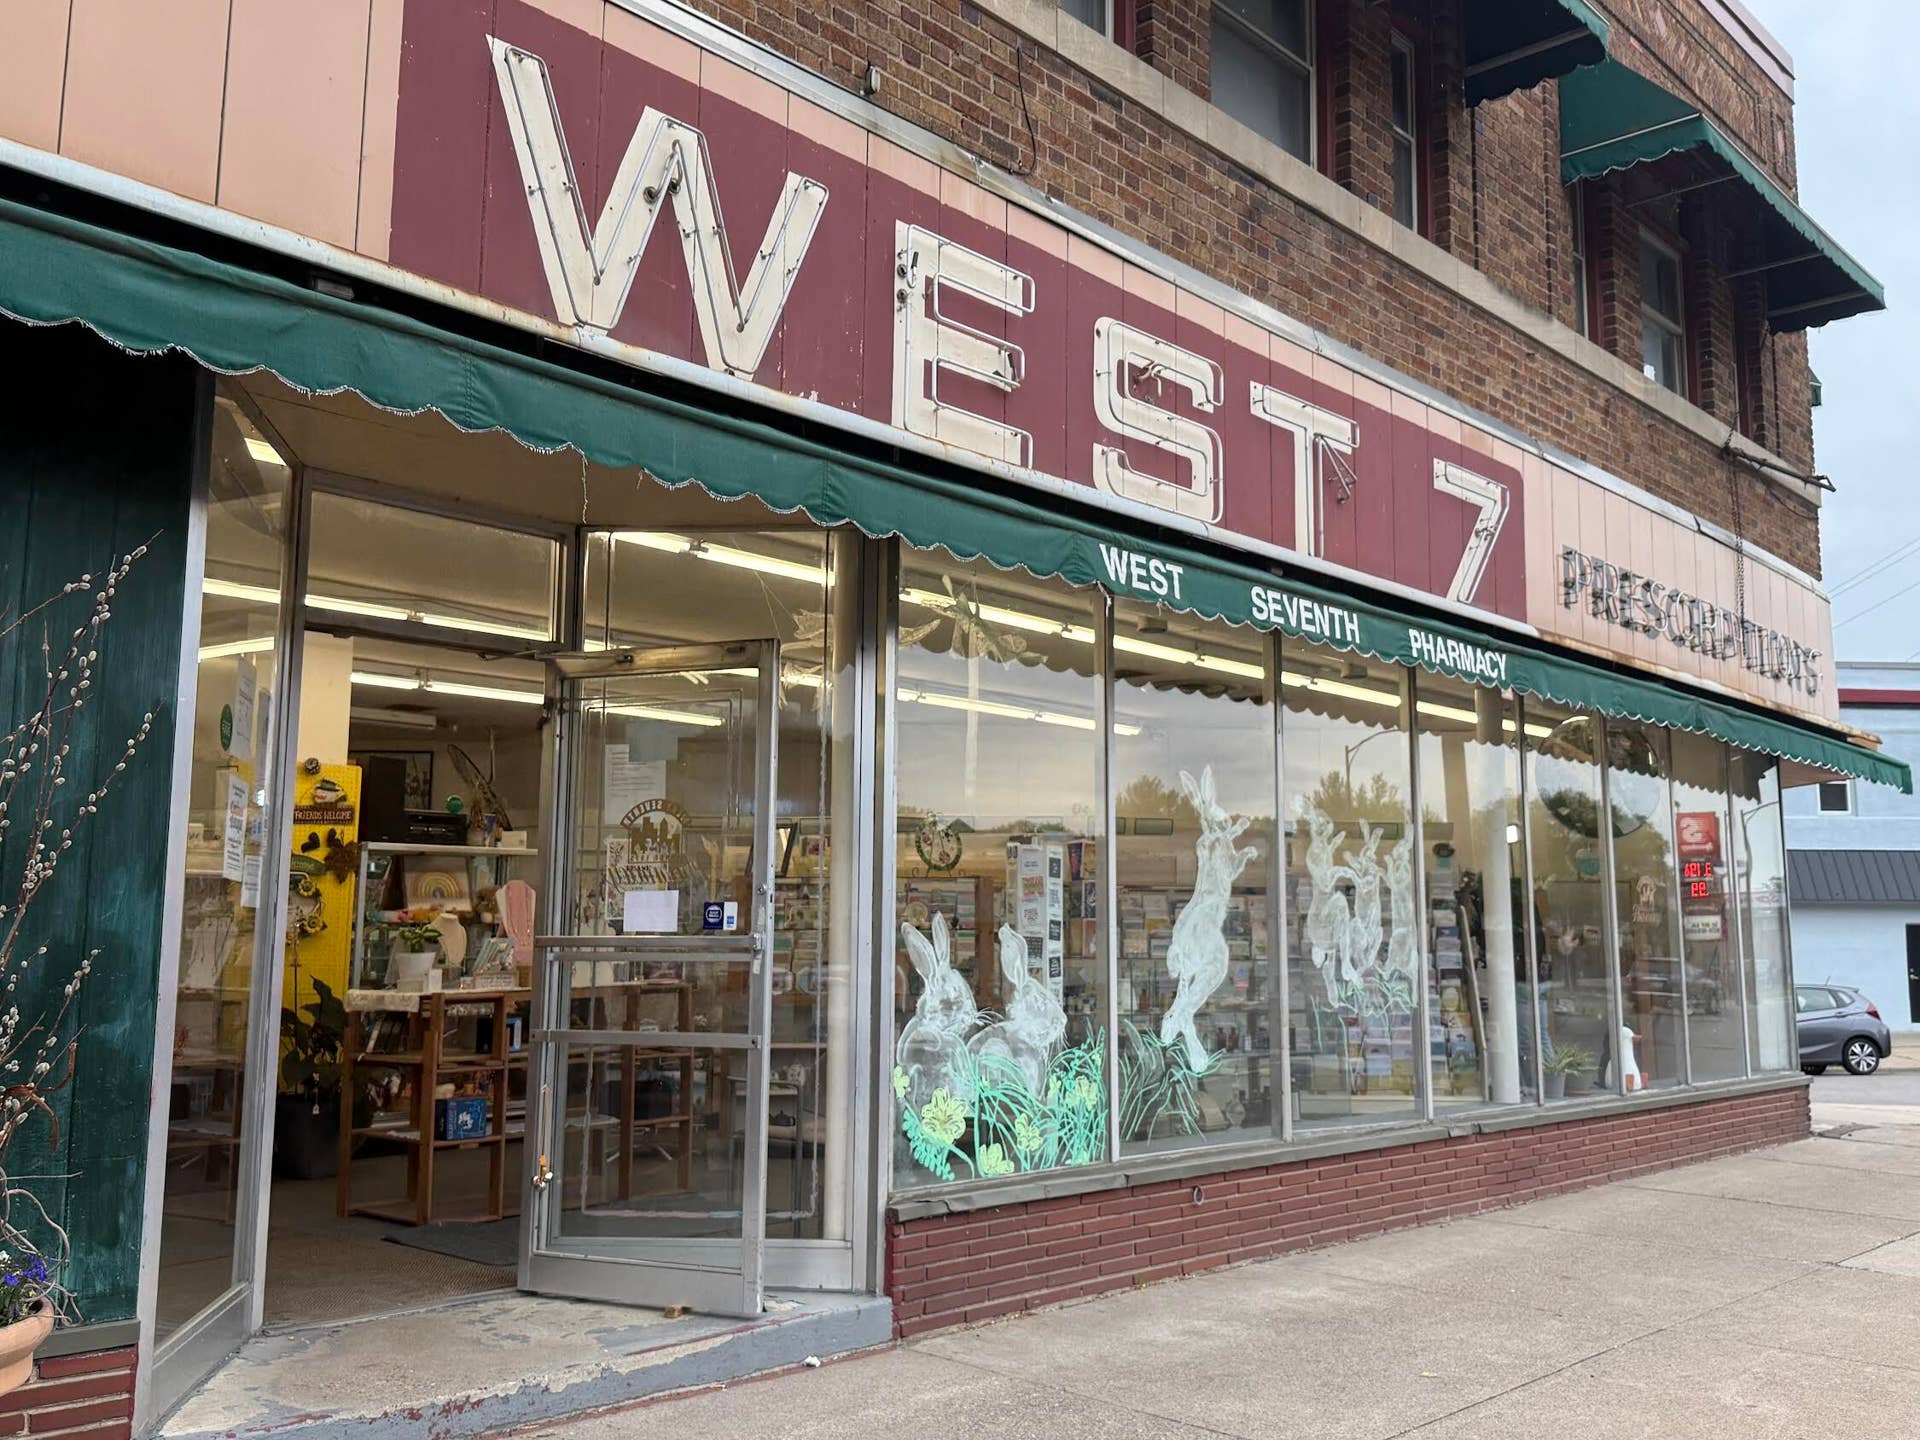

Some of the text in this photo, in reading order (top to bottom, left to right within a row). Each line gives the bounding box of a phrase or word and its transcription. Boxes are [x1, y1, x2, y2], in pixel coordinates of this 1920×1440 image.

[486, 34, 1510, 603] WEST 7
[1098, 543, 1507, 681] WEST SEVENTH PHARMACY
[1560, 544, 1823, 697] PRESCRIPTIONS
[324, 811, 352, 820] WELCOME
